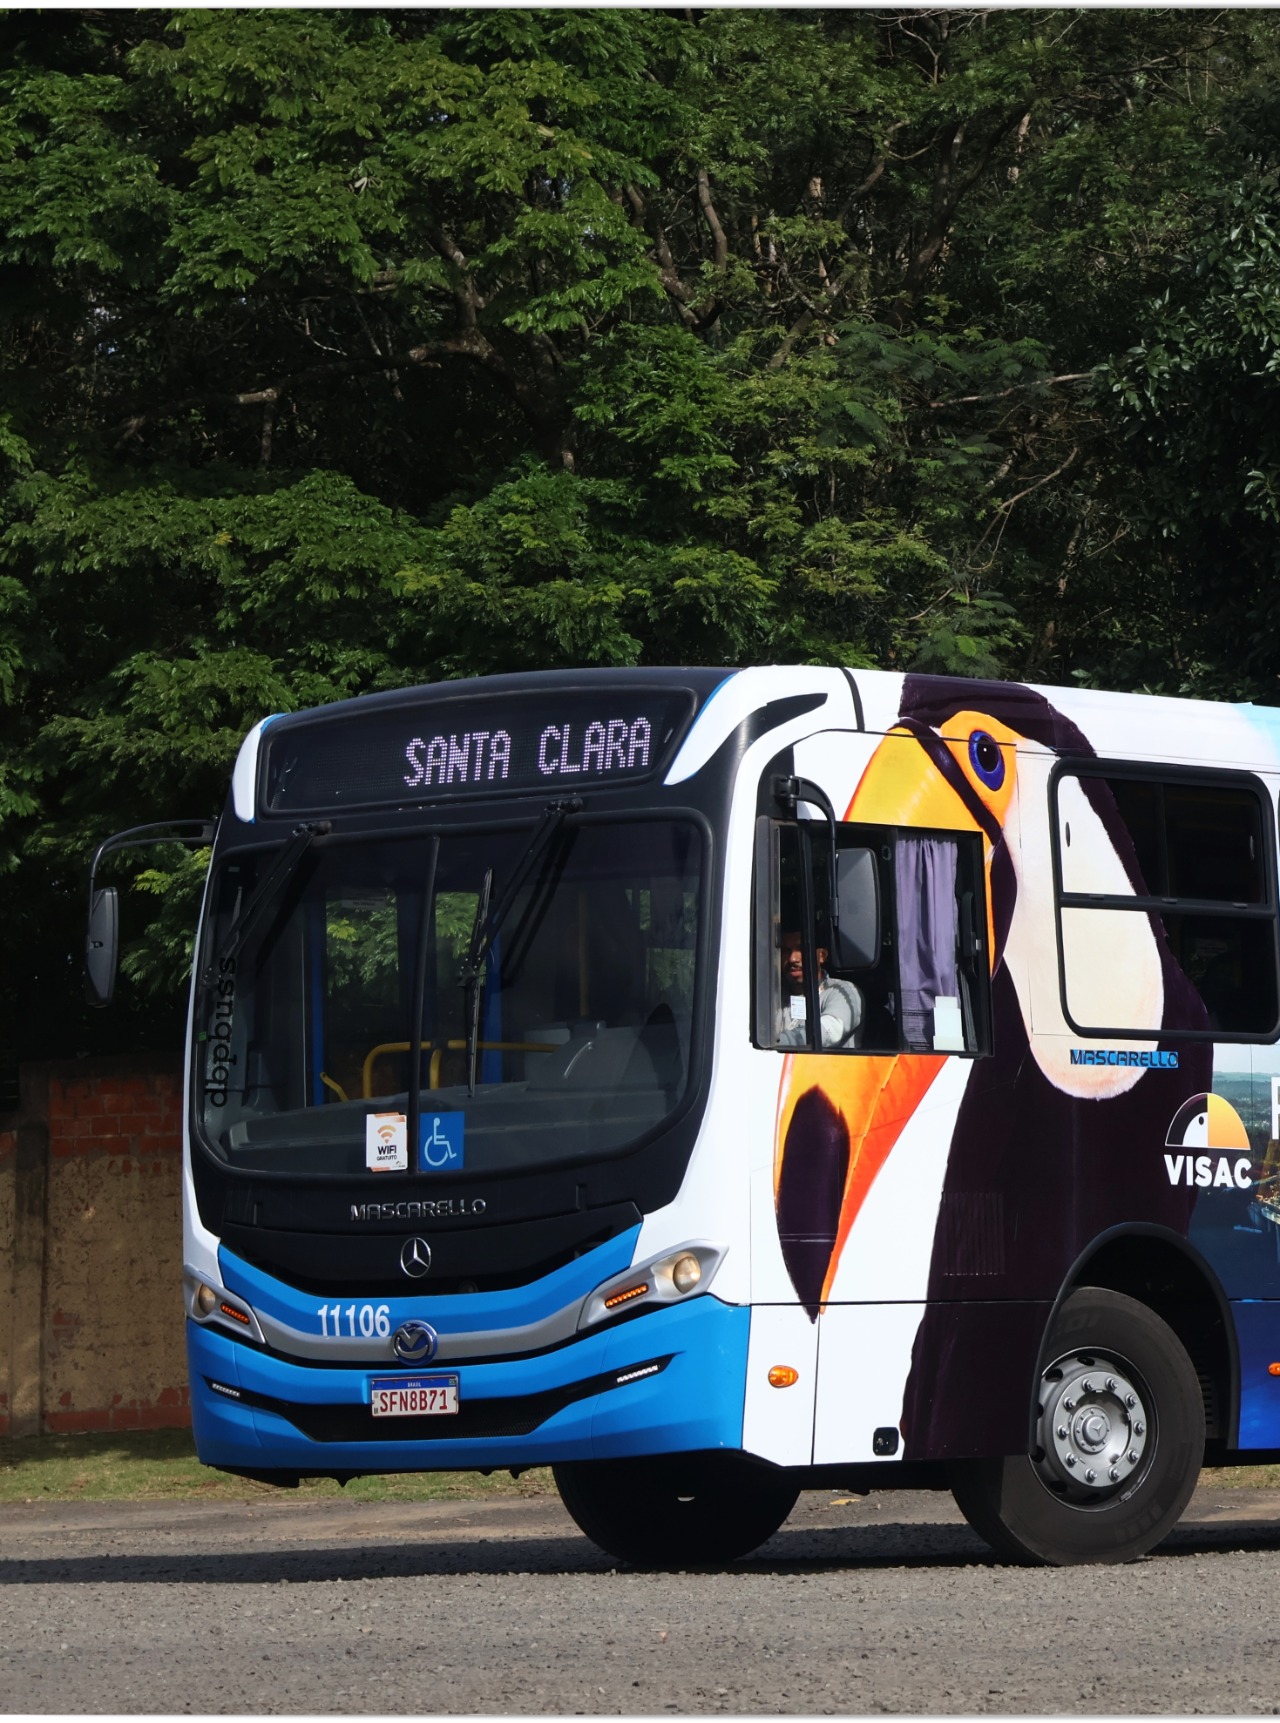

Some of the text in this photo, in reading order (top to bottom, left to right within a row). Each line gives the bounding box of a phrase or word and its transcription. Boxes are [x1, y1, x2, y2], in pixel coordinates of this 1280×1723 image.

[404, 717, 651, 786] SANTA CLARA
[1069, 1049, 1179, 1068] MASCARELLO
[377, 1144, 397, 1155] WIFI
[1164, 1154, 1252, 1189] VISAC
[350, 1198, 487, 1220] MASCARELLO
[317, 1304, 391, 1338] 11106
[380, 1389, 448, 1412] SFN8B71
